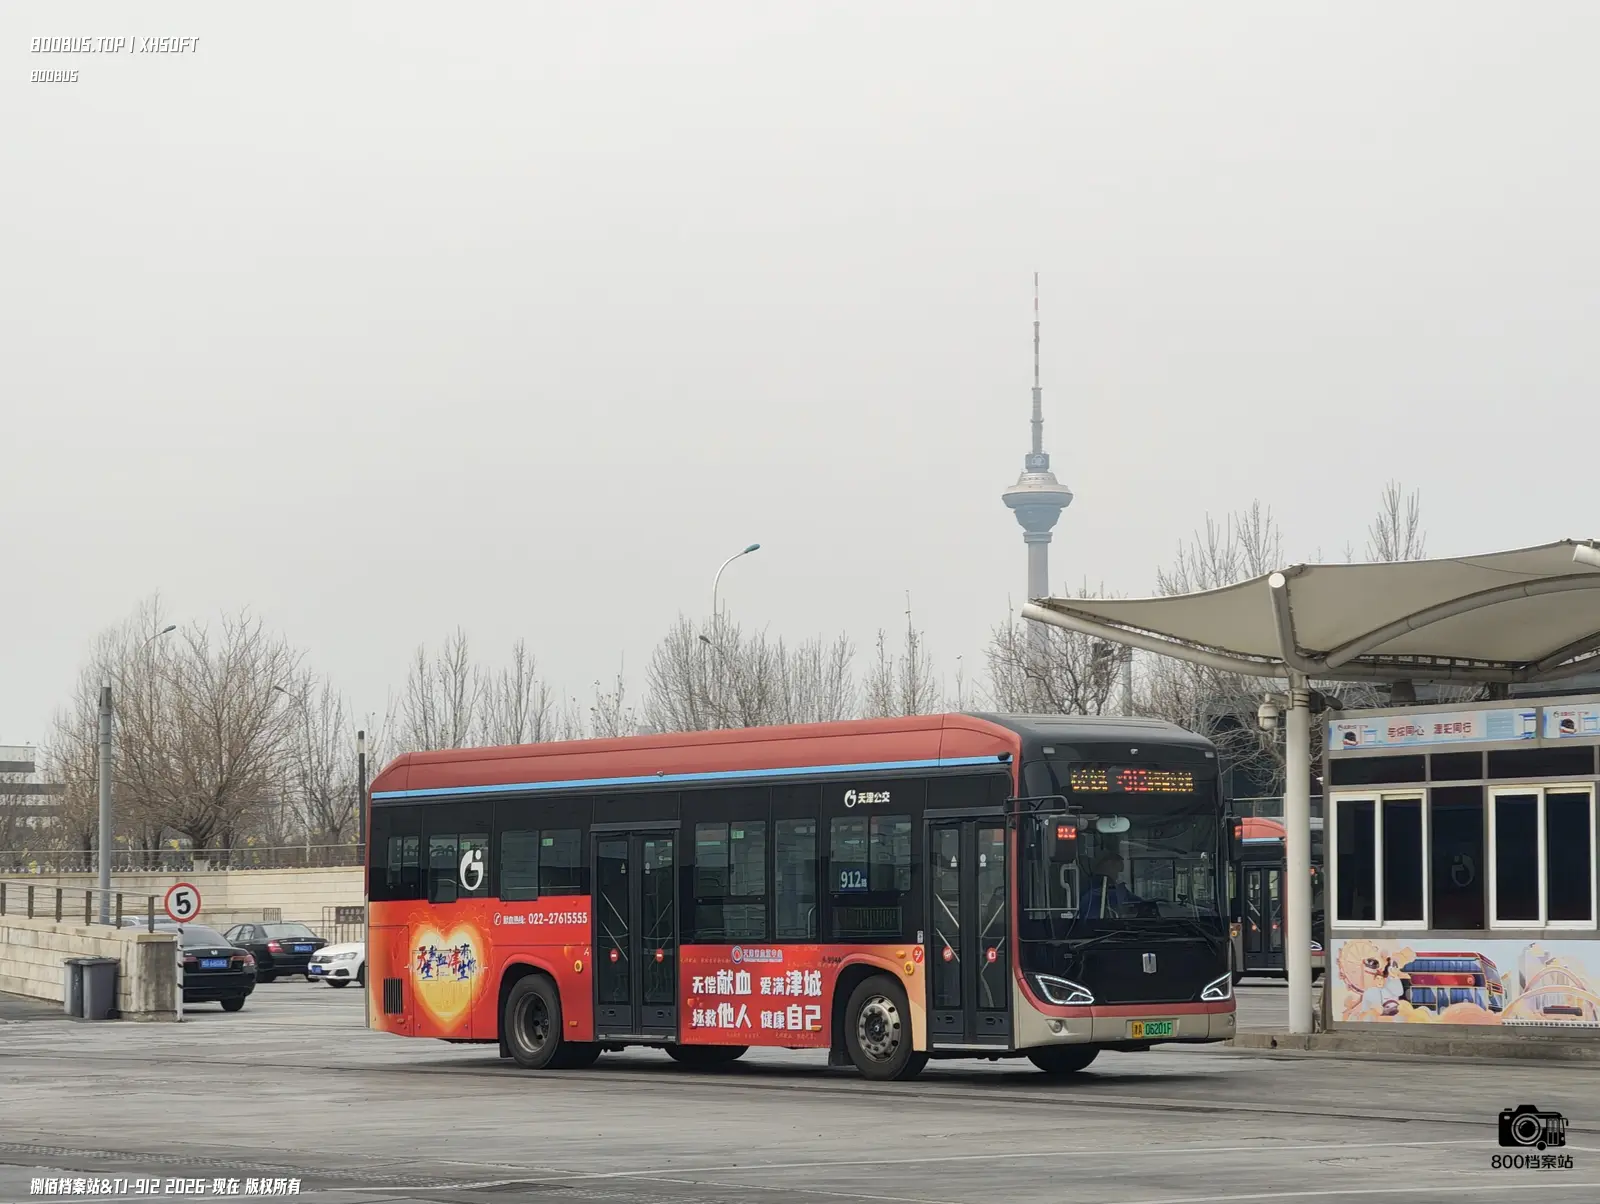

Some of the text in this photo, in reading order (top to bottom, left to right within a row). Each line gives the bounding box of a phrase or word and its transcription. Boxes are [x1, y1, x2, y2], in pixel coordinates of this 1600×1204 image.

[857, 791, 891, 804] 天津公交
[175, 891, 192, 915] 5
[528, 912, 588, 925] 022-27615555
[692, 969, 822, 997] 无偿献血 爱满津城
[692, 1002, 822, 1031] 拯救他人 健康自己
